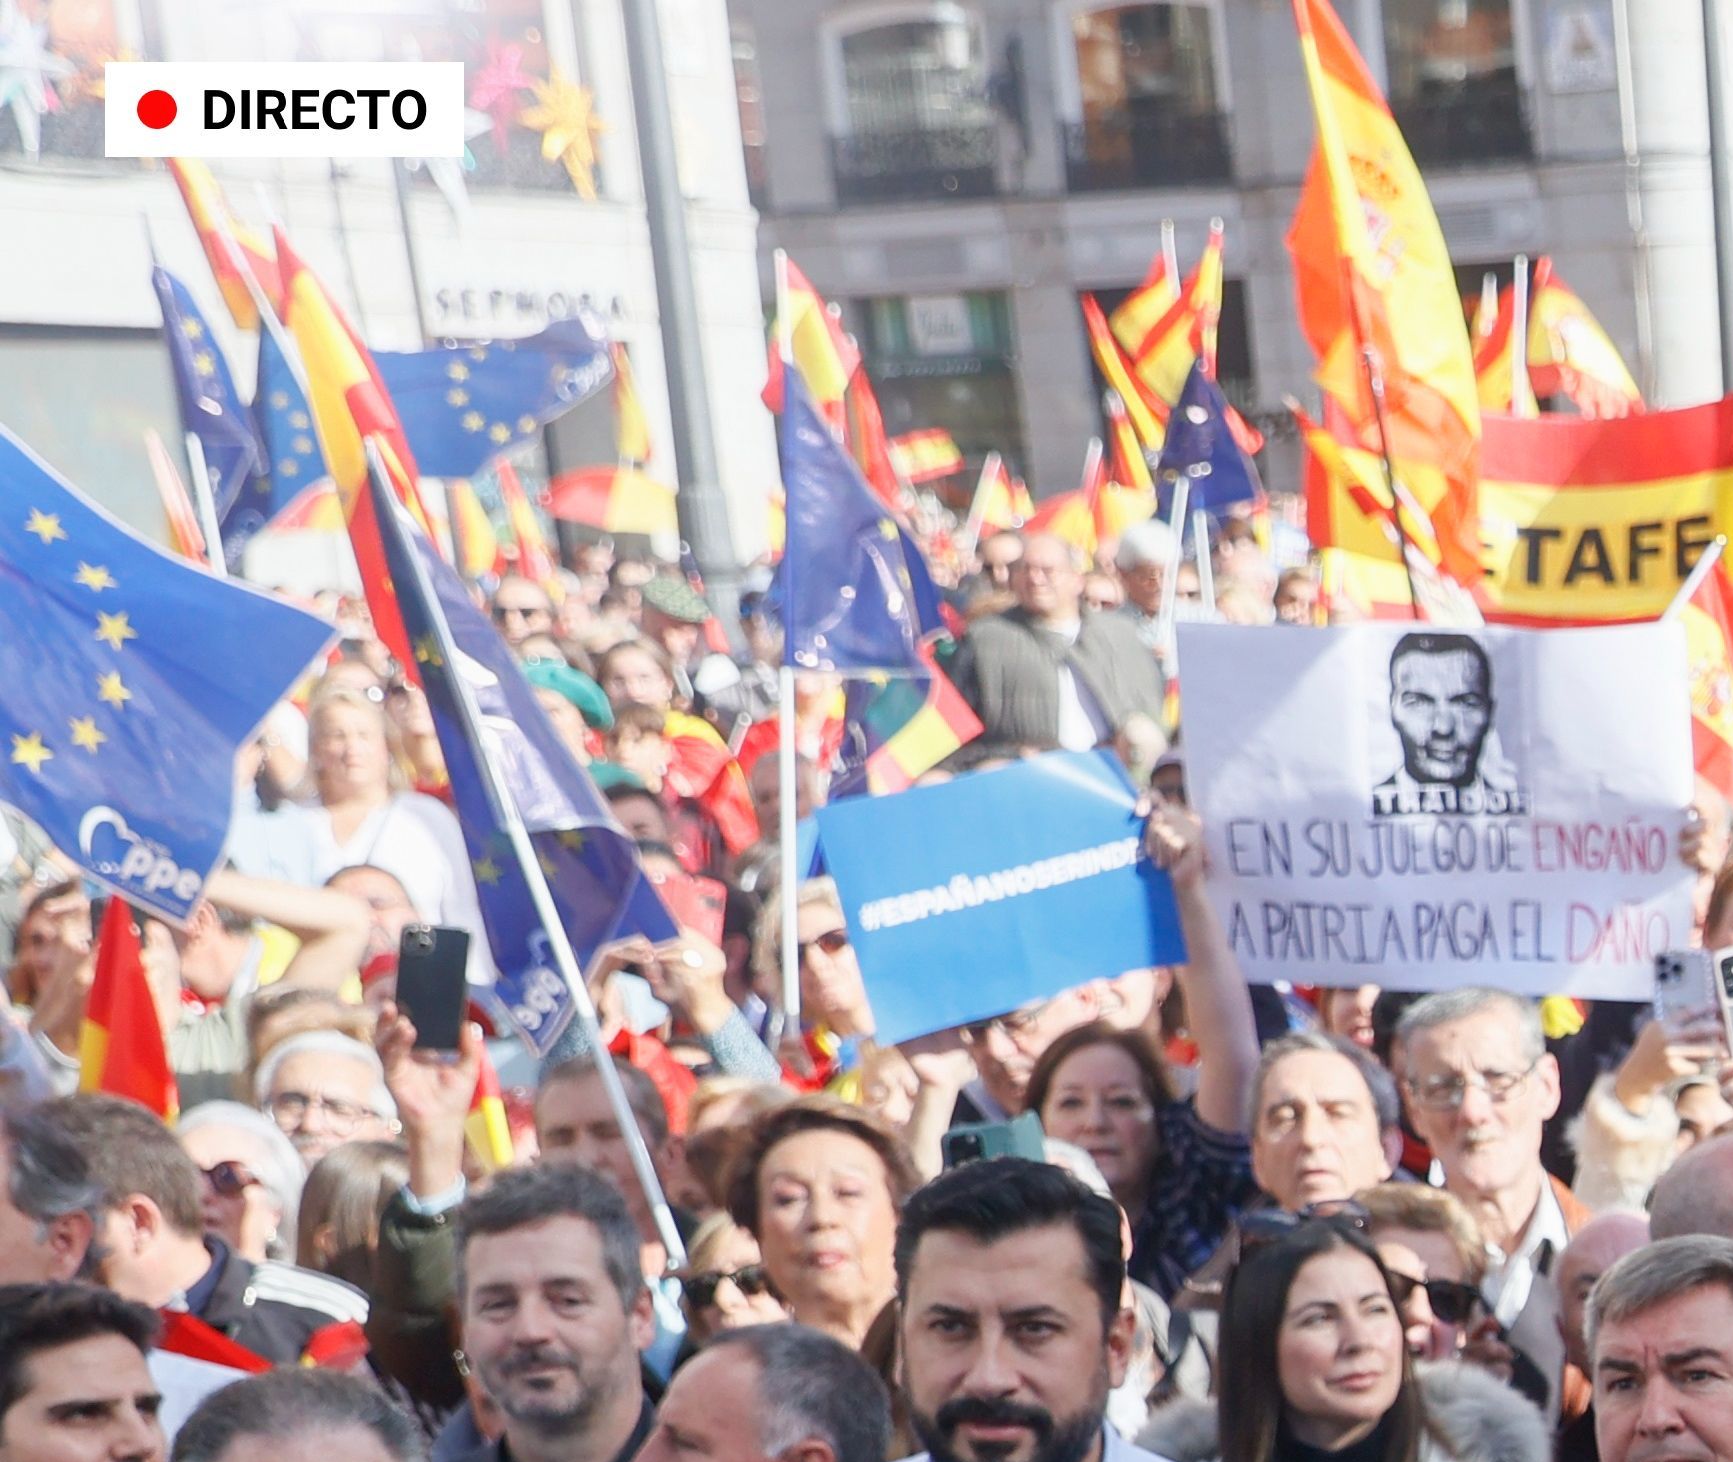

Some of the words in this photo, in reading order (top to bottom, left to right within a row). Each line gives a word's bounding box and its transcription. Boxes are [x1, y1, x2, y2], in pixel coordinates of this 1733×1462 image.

[1482, 516, 1716, 585] TAFE
[119, 843, 202, 901] ppe
[1226, 818, 1293, 878] EN
[1304, 818, 1351, 878] SU
[1360, 819, 1477, 878] JUEGO
[1486, 820, 1524, 873] DE
[1533, 816, 1668, 874] ENGAÑO
[1262, 900, 1408, 964] PATRIA
[1412, 900, 1500, 961] PAGA
[1510, 900, 1555, 962] EL
[1566, 898, 1671, 965] DAÑO
